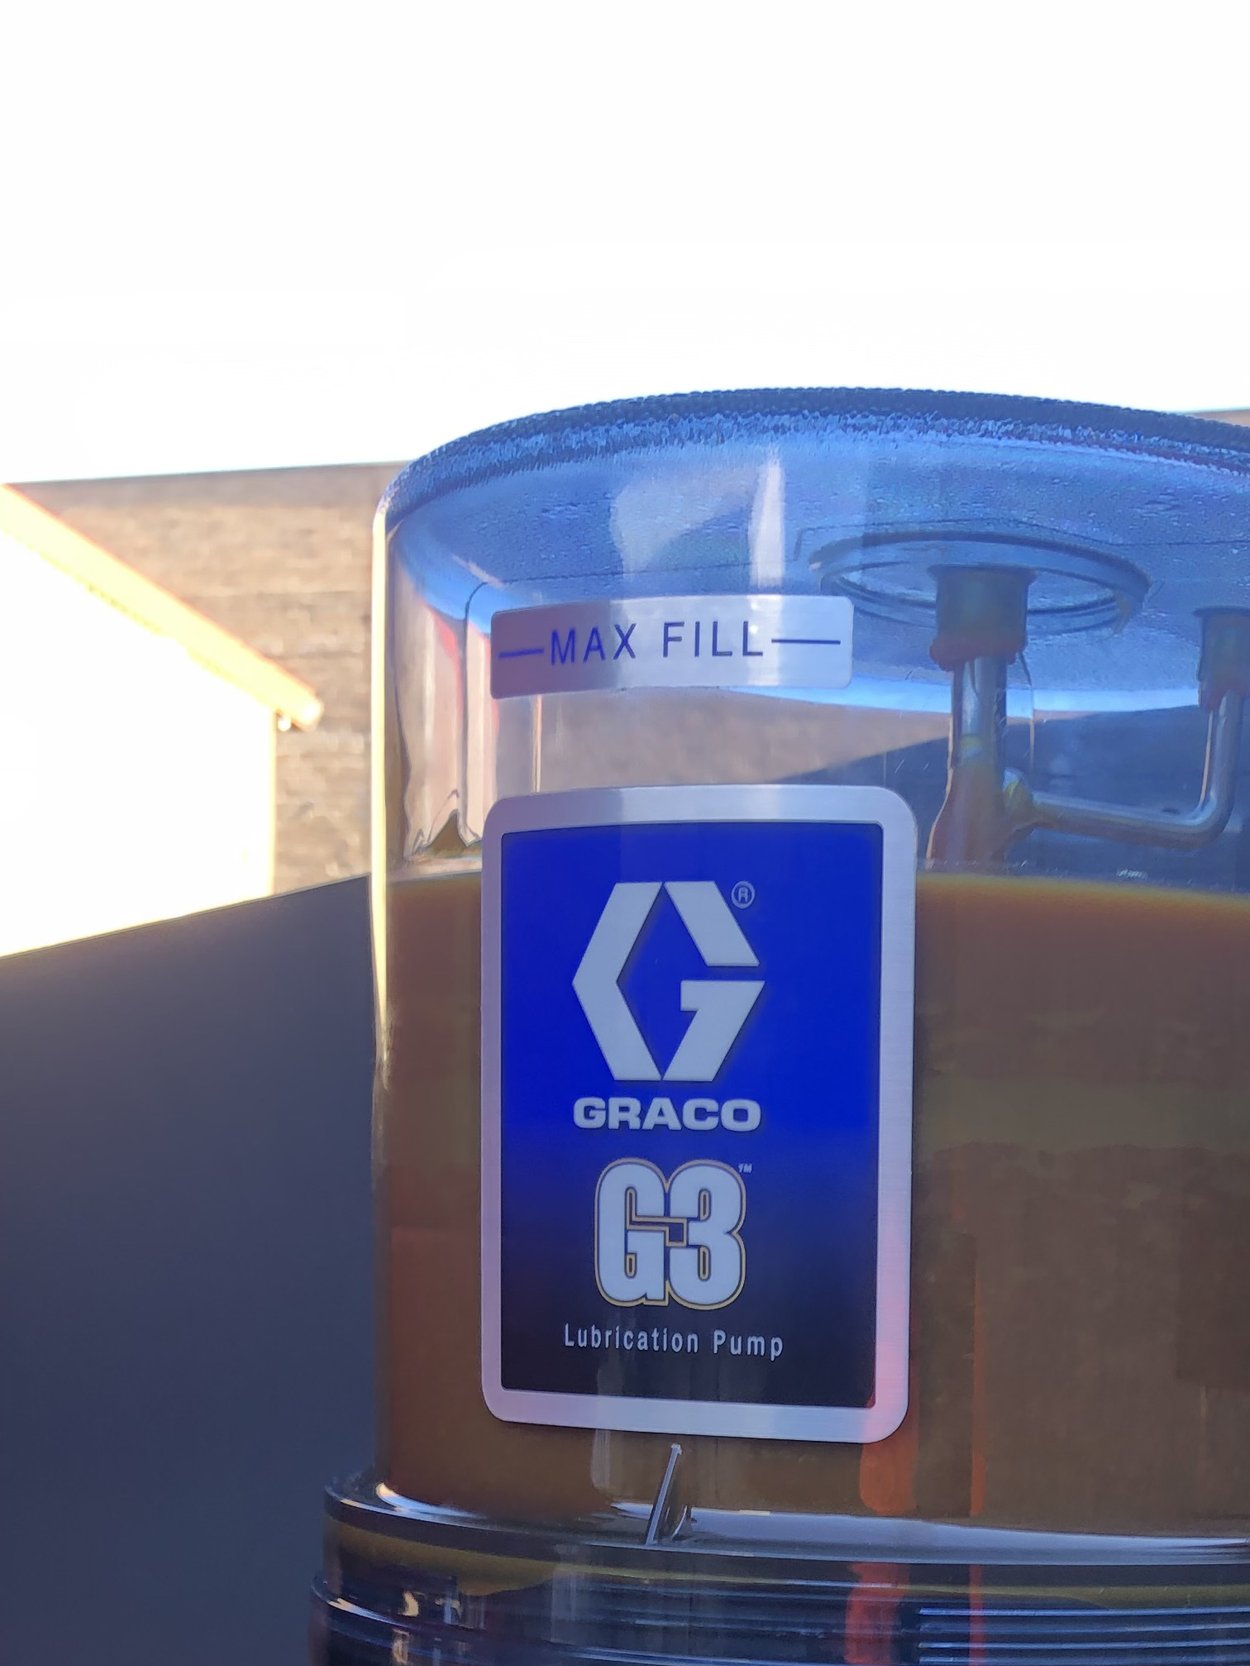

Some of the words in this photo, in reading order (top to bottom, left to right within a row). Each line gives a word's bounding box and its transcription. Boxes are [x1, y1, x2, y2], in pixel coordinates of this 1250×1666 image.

[550, 623, 636, 666] MAX
[662, 620, 764, 658] FILL
[573, 1096, 762, 1132] GRACO
[594, 1157, 747, 1311] G3
[564, 1322, 699, 1353] Lubrication
[713, 1329, 784, 1361] Pump
